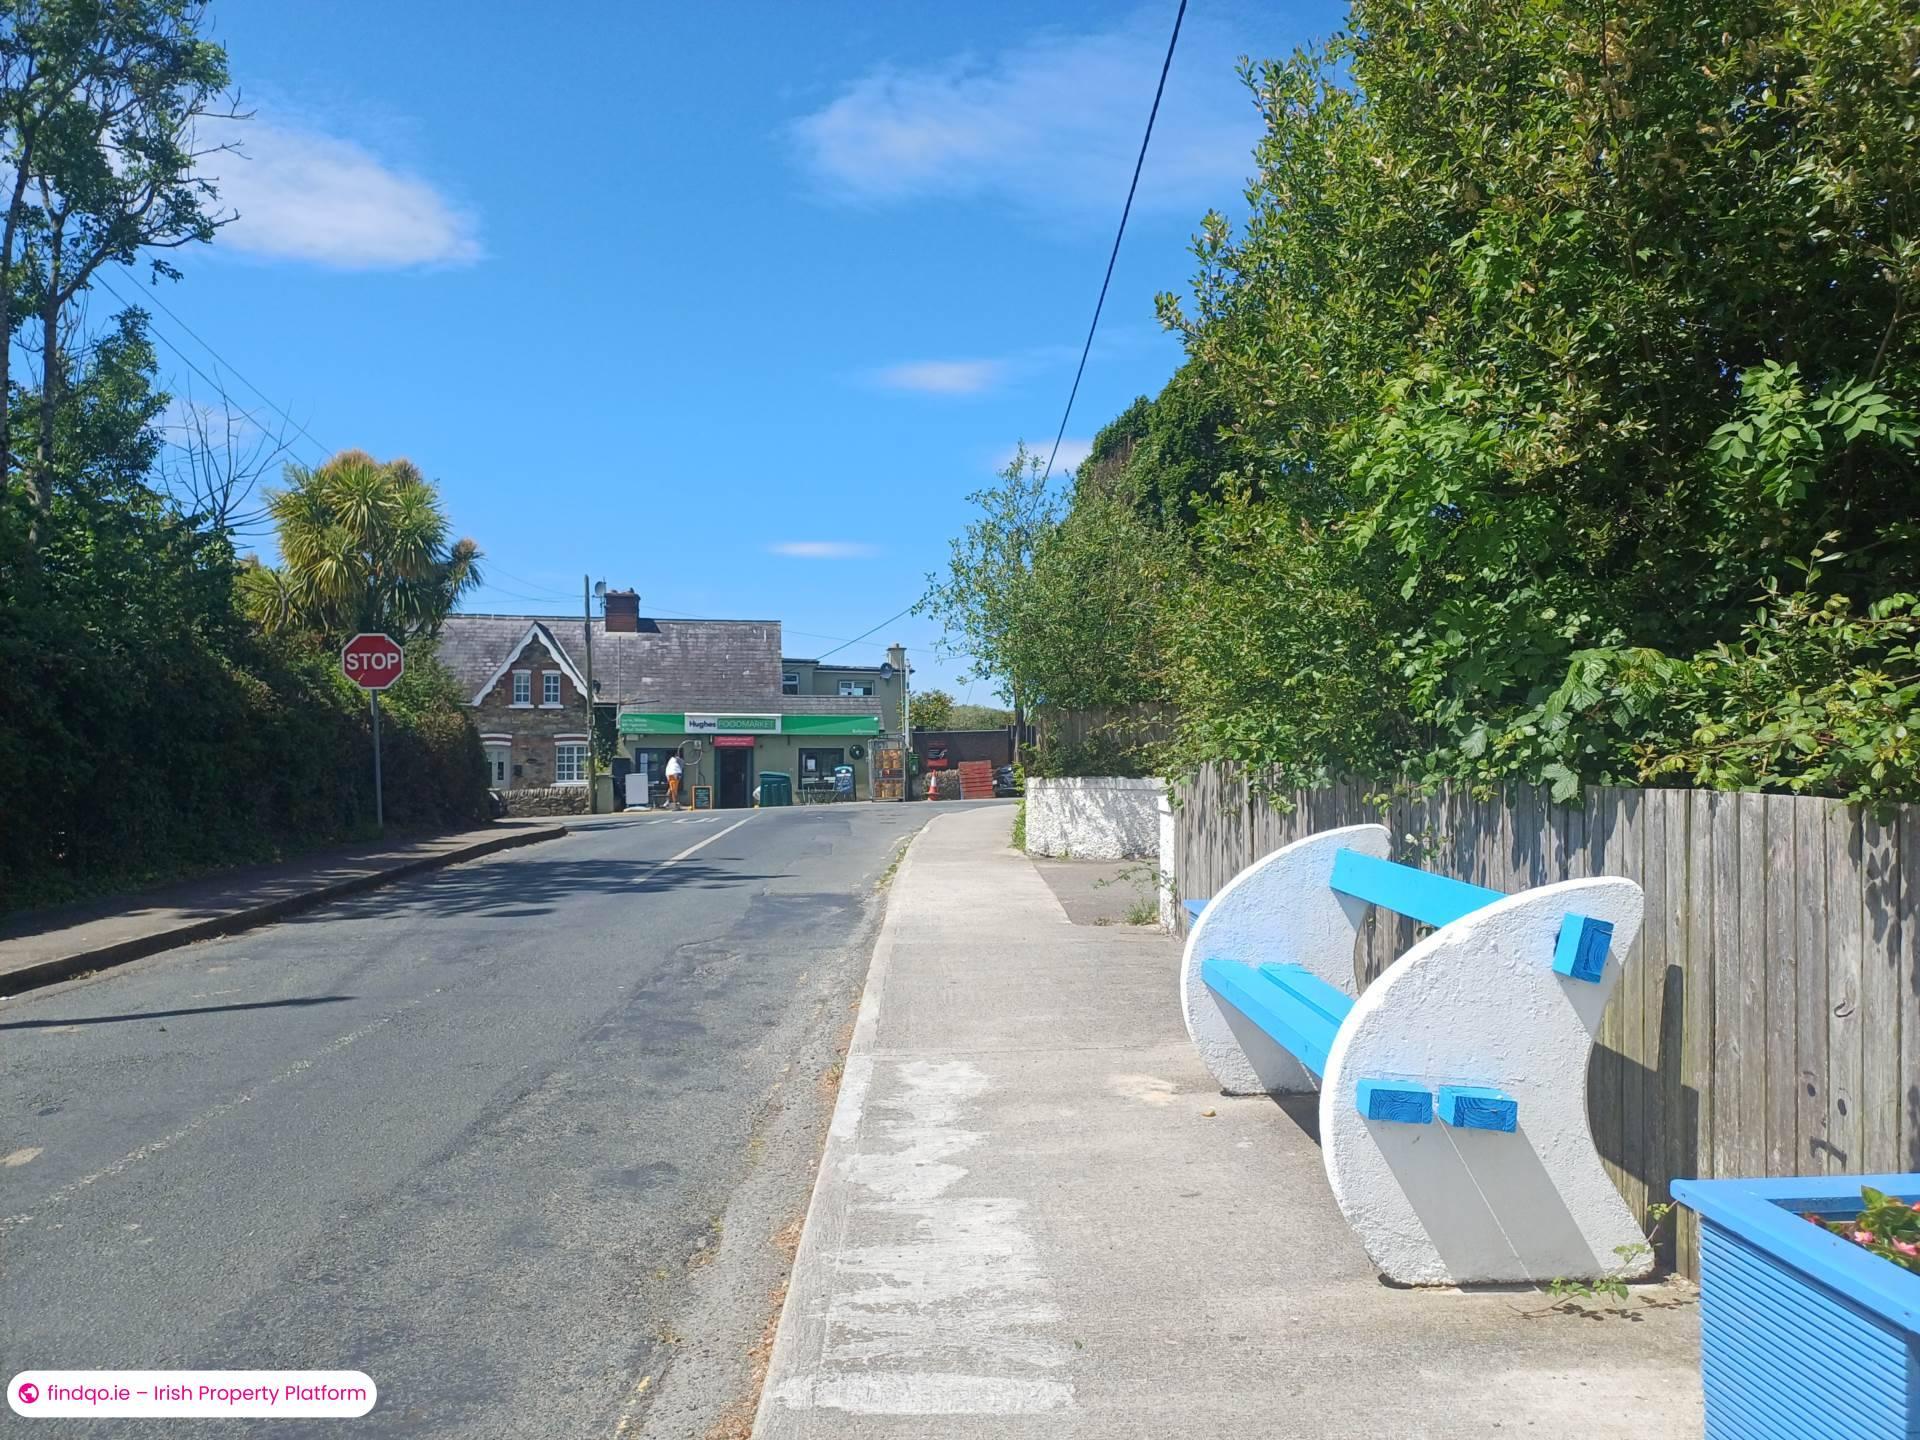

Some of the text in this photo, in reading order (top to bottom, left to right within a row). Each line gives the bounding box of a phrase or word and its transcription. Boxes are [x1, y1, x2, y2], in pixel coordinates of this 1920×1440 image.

[346, 653, 399, 670] STOP
[689, 719, 774, 729] Hughes FOODMARKET
